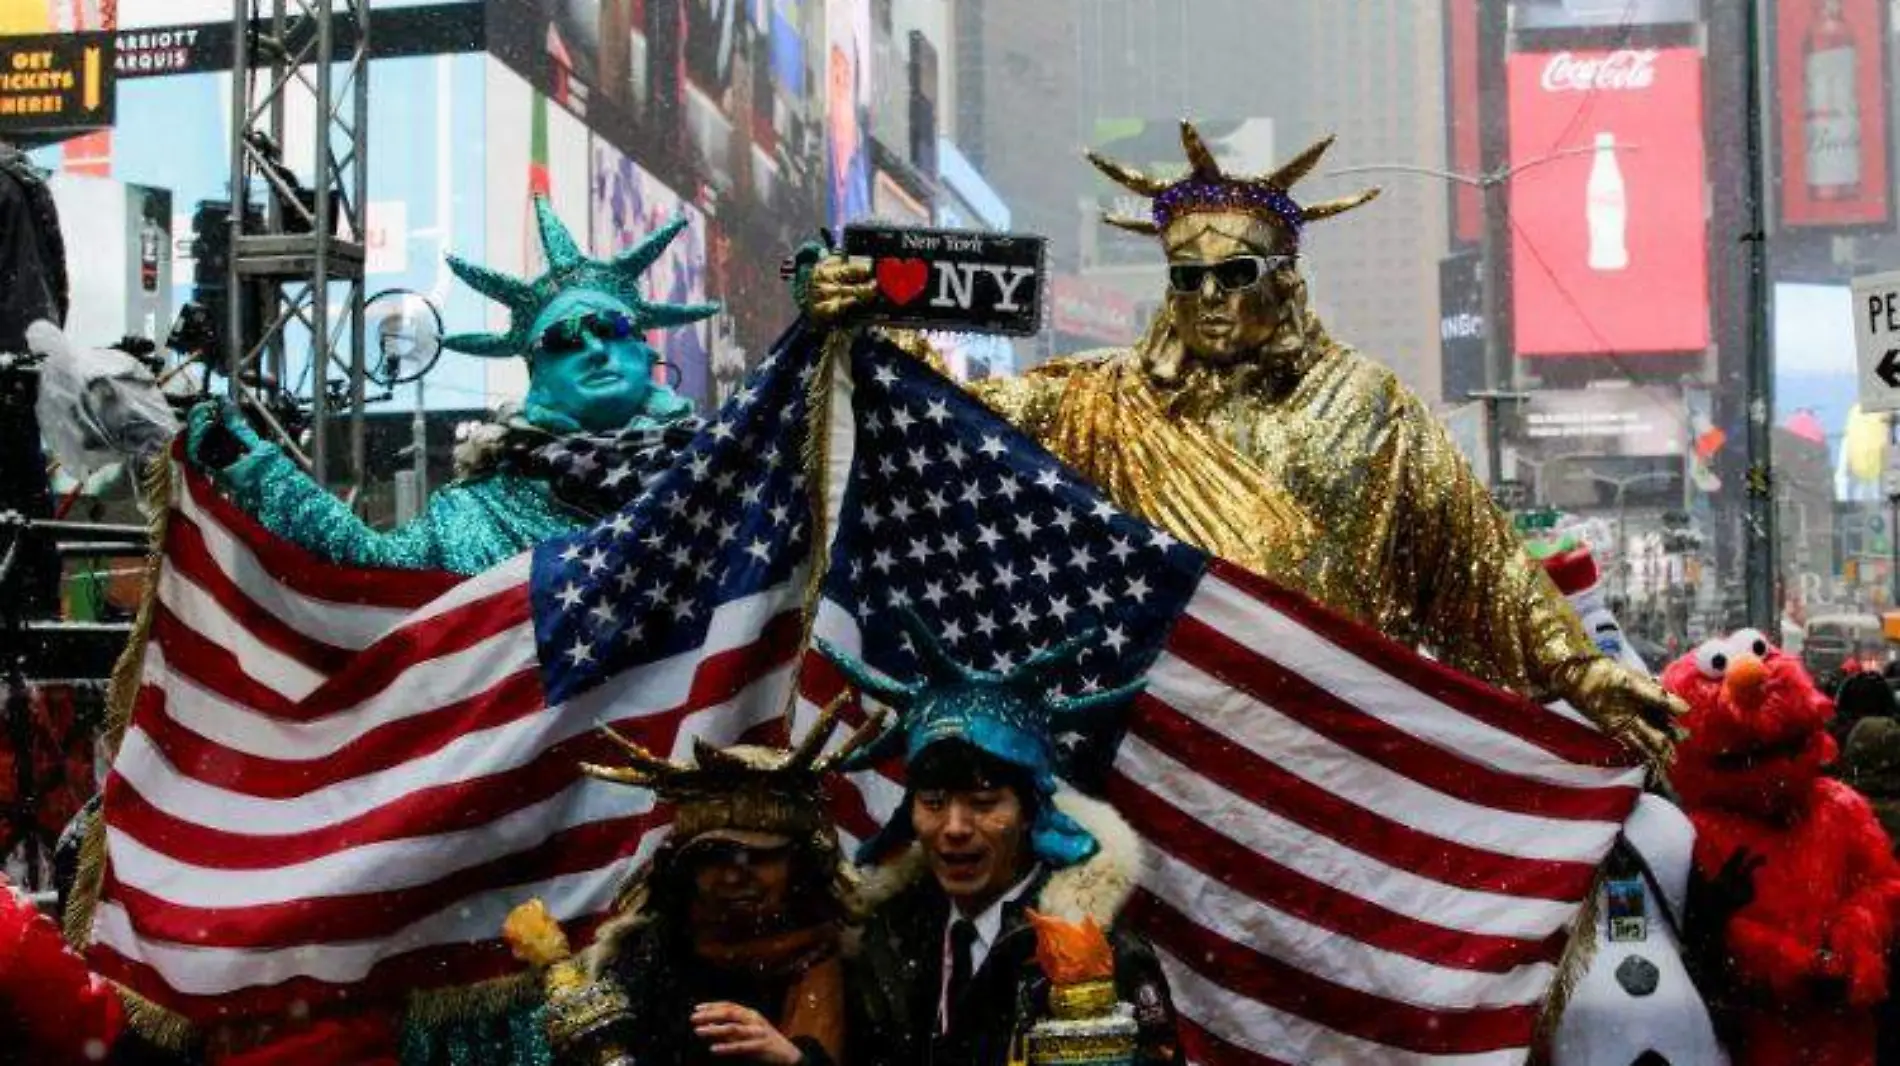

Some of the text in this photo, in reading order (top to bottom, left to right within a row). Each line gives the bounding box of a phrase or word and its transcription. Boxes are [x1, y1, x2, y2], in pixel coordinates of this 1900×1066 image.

[12, 51, 53, 69] GET
[0, 71, 74, 90] ICKETS
[930, 259, 1035, 312] NY
[1868, 292, 1900, 334] PE
